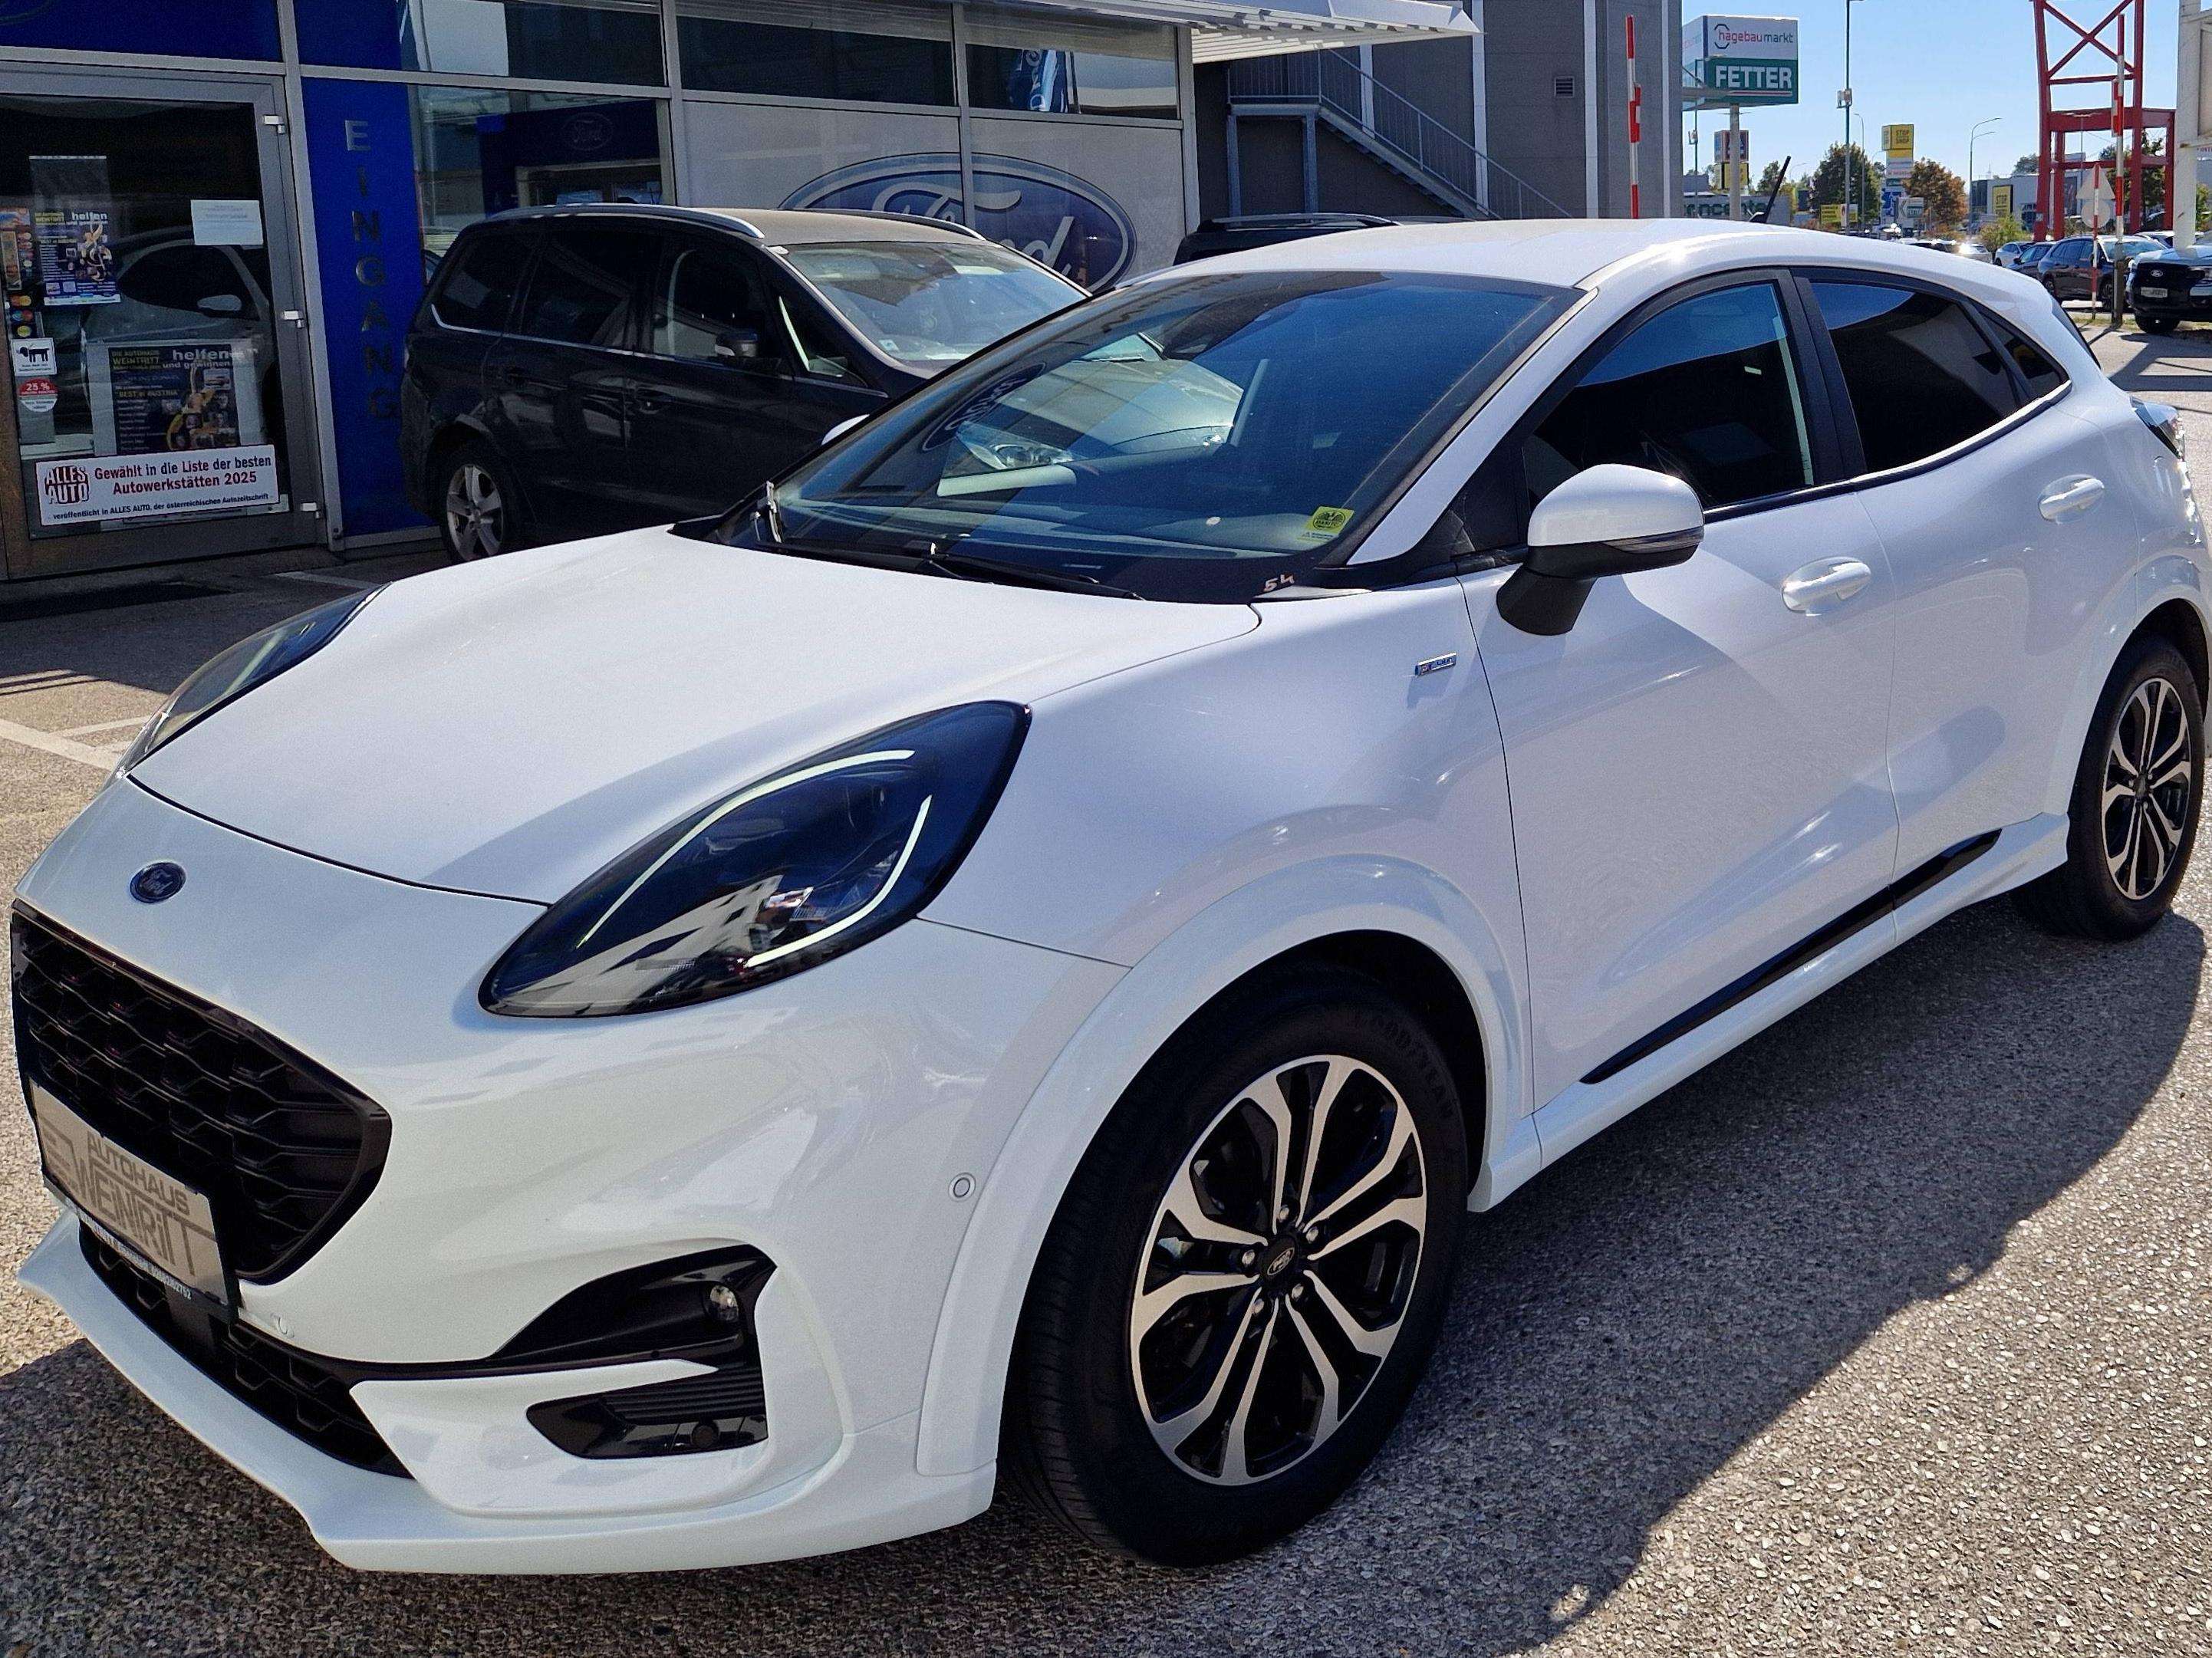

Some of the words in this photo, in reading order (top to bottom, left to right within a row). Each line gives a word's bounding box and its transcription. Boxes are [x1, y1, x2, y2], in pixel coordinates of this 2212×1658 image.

[1718, 31, 1794, 44] hagebaumarkt
[1715, 65, 1792, 89] FETTER
[344, 119, 401, 419] EINGANG
[173, 349, 230, 360] helfen
[26, 383, 38, 392] 25
[45, 465, 88, 485] ALLES
[94, 463, 143, 480] Gewählt
[145, 463, 157, 476] in
[160, 462, 178, 475] die
[183, 460, 209, 472] Liste
[212, 458, 231, 470] der
[234, 456, 272, 469] besten
[48, 482, 90, 504] AUTO
[113, 476, 220, 495] Autowerkstätten
[224, 471, 257, 485] 2025
[53, 509, 100, 520] veröffentlicht
[110, 505, 131, 515] ALLES
[87, 1130, 190, 1216] AUTOHAUS
